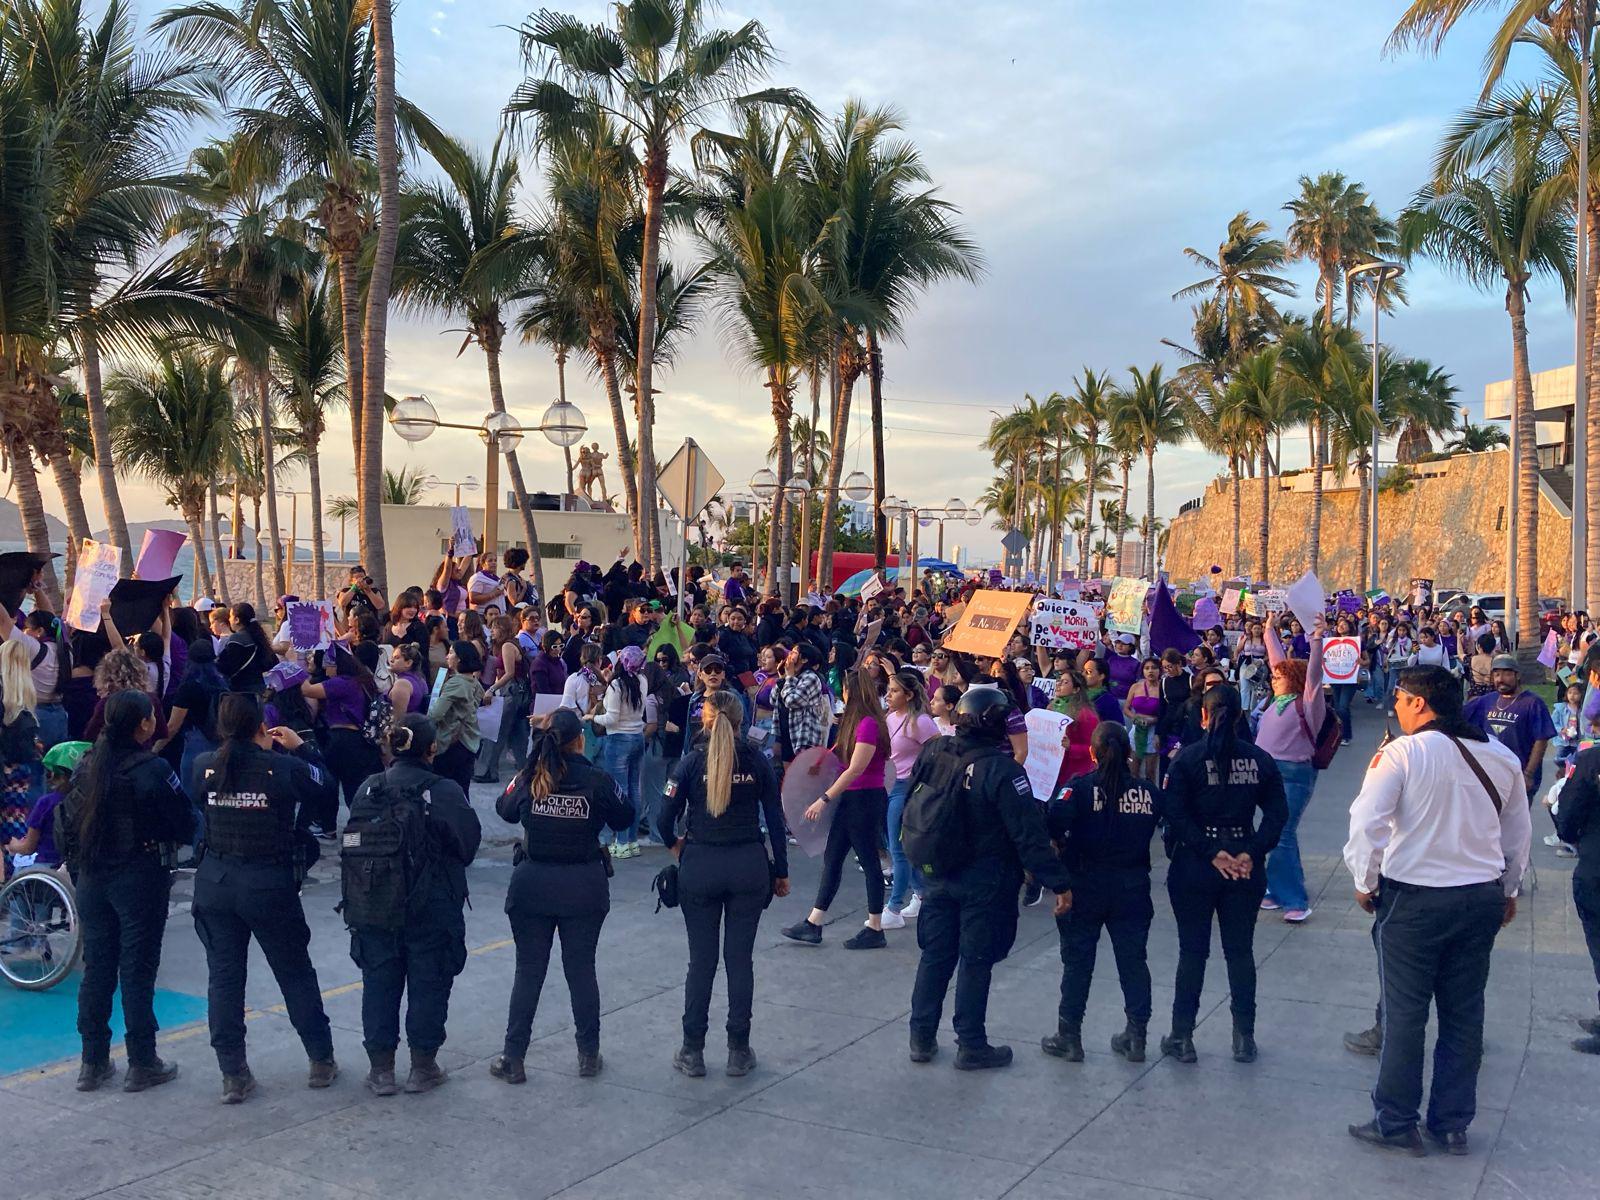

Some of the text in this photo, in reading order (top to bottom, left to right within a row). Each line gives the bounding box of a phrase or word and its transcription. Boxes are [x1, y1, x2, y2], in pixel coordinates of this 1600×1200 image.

[1037, 601, 1078, 616] Quiero
[1064, 615, 1088, 627] MORIR
[1035, 623, 1049, 635] De
[1082, 630, 1096, 641] NO
[1034, 633, 1051, 647] Por
[534, 803, 587, 817] MUNICIPAL
